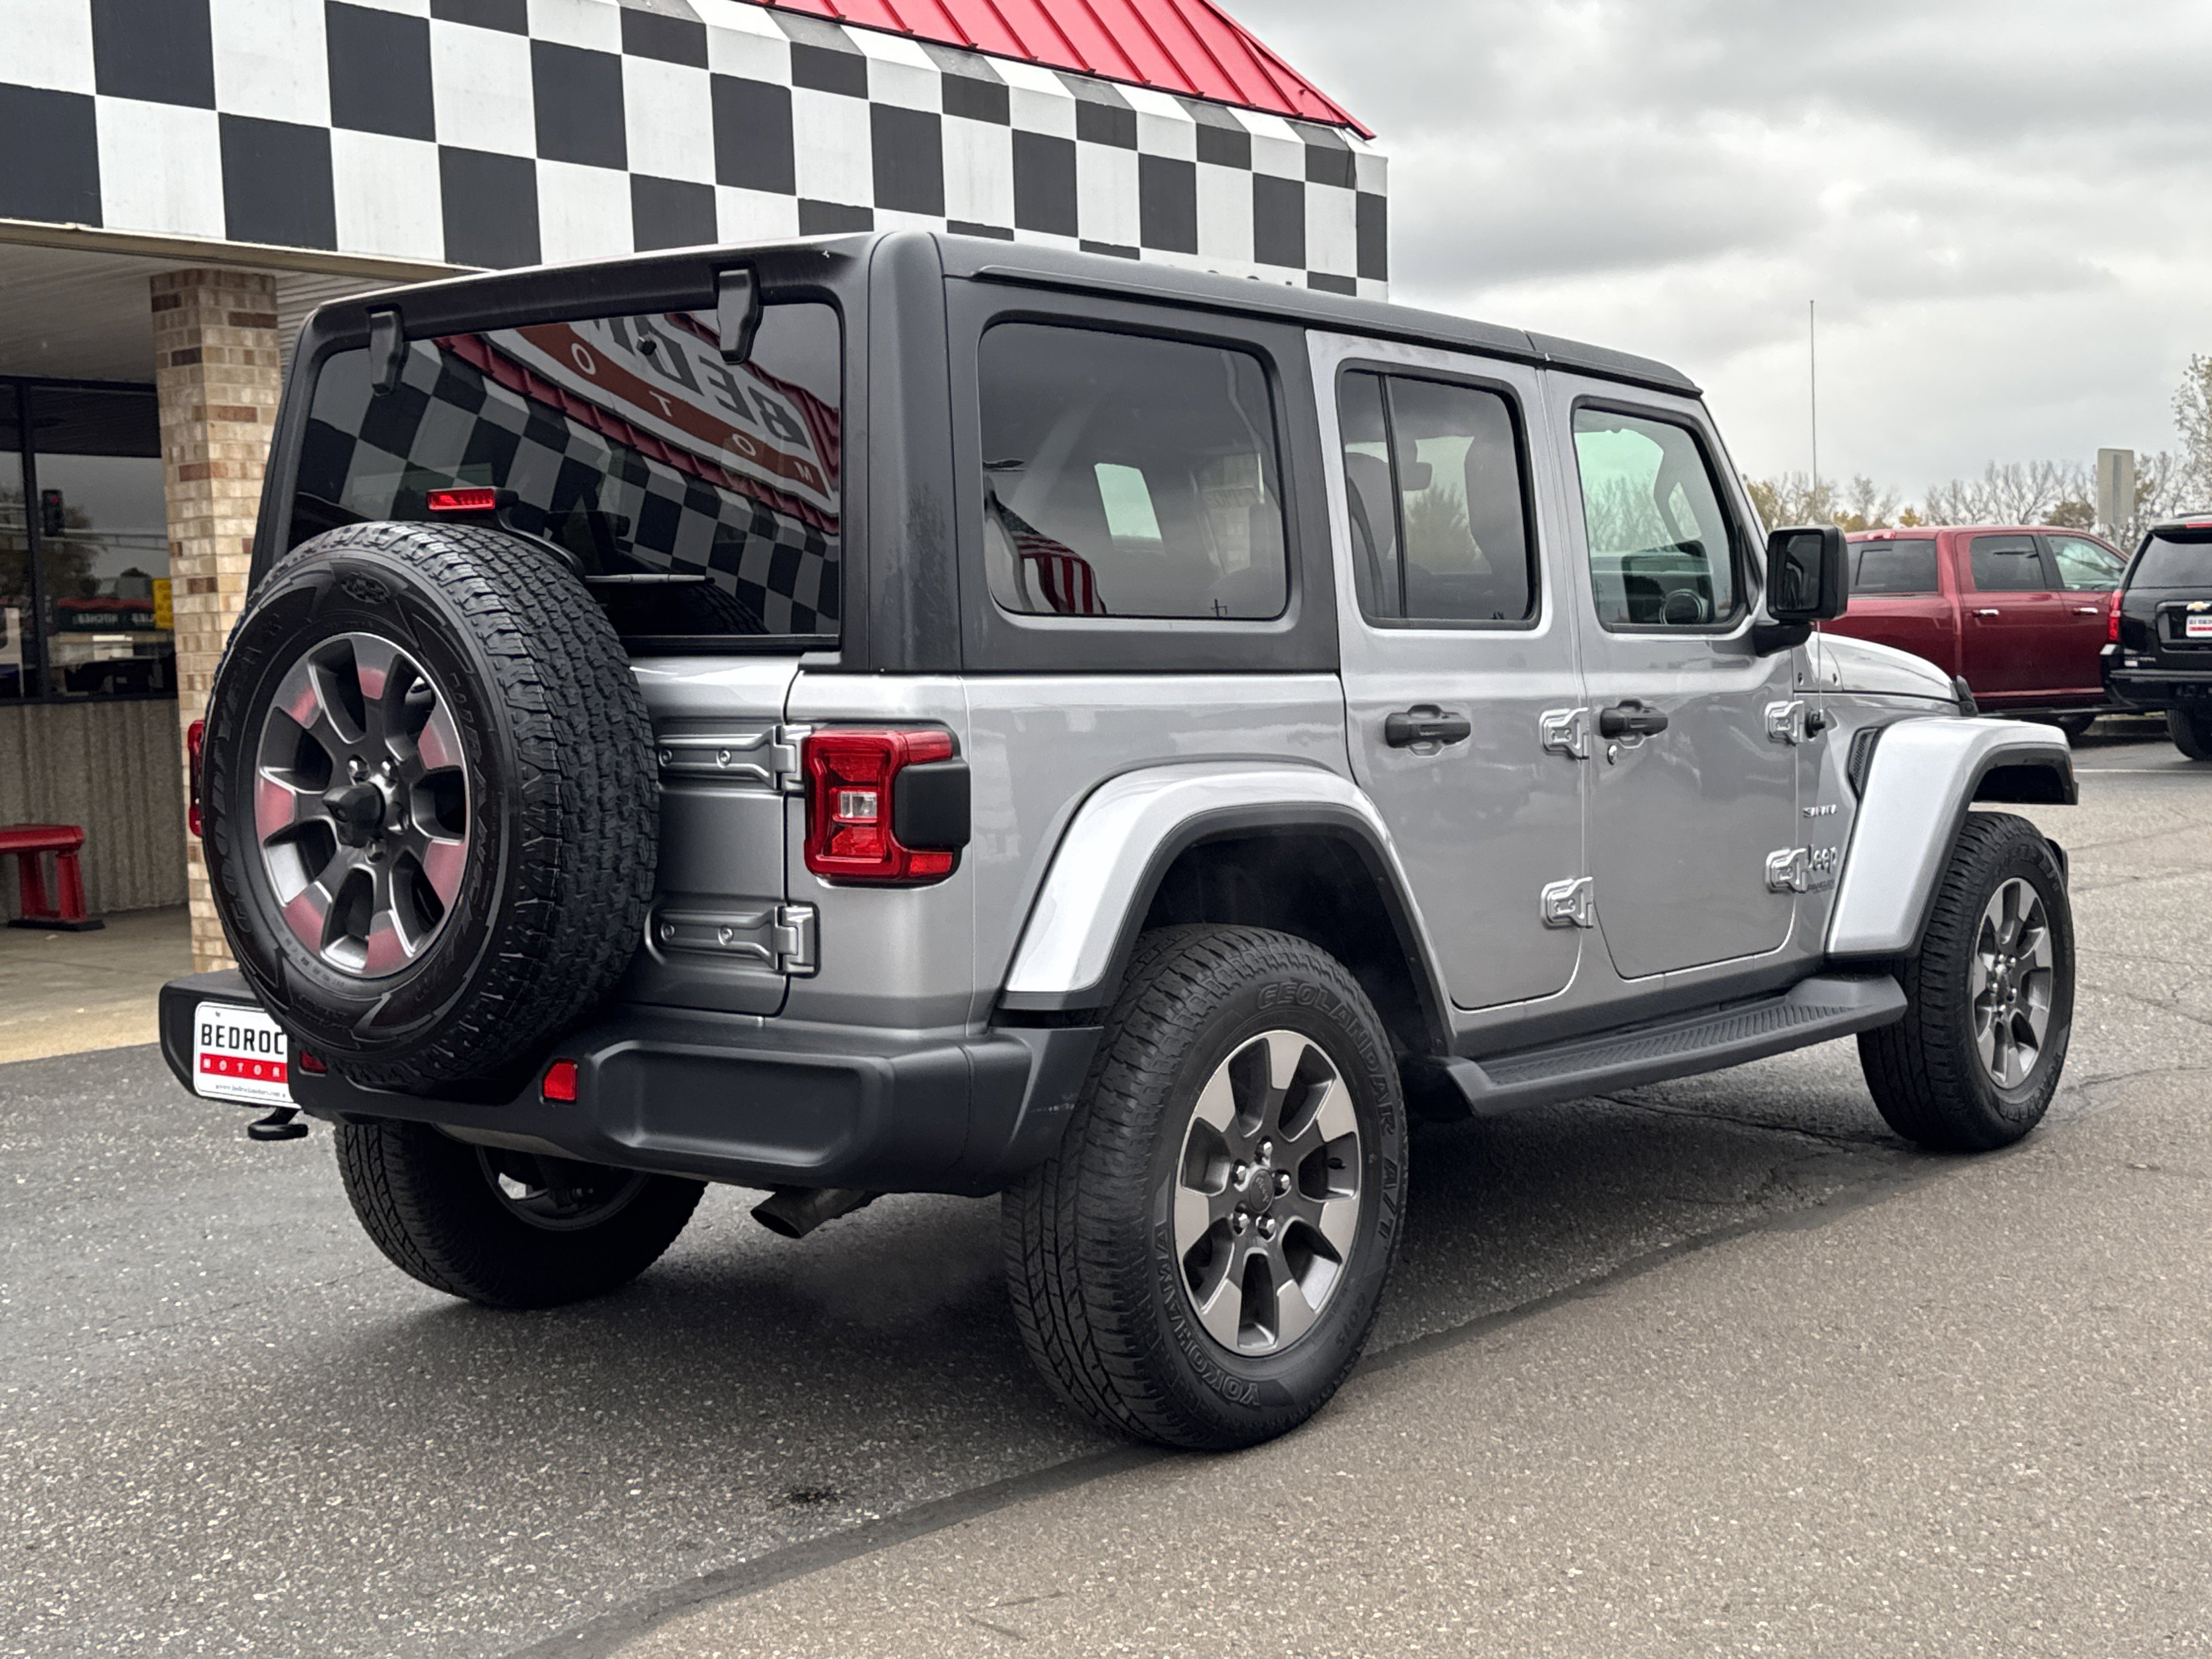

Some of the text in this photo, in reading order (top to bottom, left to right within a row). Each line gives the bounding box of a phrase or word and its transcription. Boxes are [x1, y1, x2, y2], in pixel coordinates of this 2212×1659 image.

[202, 1058, 280, 1078] MOTOR
[1257, 981, 1396, 1137] GEOLANDAR
[1155, 1226, 1261, 1407] YOKOHAMA
